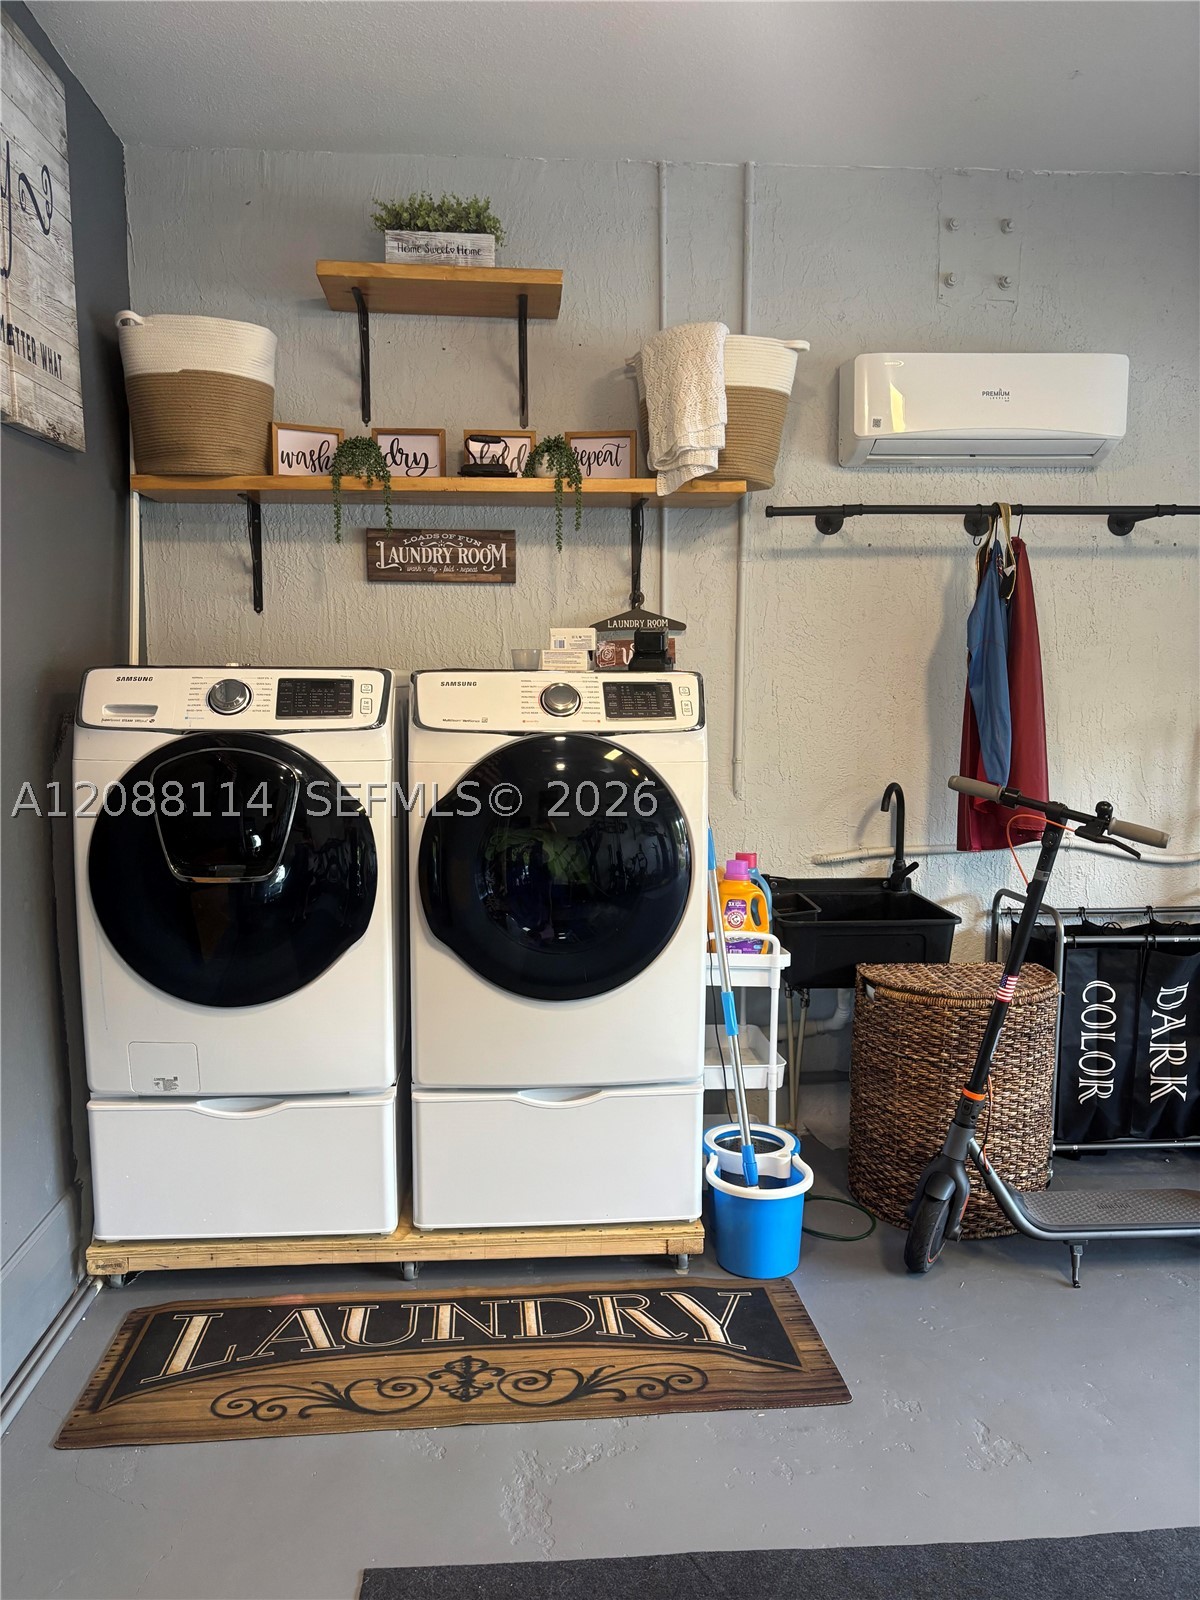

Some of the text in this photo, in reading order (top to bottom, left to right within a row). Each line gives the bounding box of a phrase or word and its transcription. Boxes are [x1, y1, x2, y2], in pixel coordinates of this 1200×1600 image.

[397, 242, 482, 255] Home Sweet Home
[41, 341, 63, 380] WHAT
[981, 388, 1010, 397] PREMIUM
[280, 440, 334, 473] wash
[383, 438, 438, 477] dry
[573, 443, 628, 477] repeat
[375, 540, 507, 572] LAUNDRY ROOM
[403, 533, 440, 545] LOADS
[458, 535, 482, 546] FUN
[427, 565, 438, 574] dry
[443, 565, 454, 573] fold
[607, 619, 669, 628] LAUNDRY ROOM
[1078, 980, 1117, 1105] COLOR
[1149, 982, 1189, 1103] DARK
[141, 1291, 751, 1384] LAUNDRY
